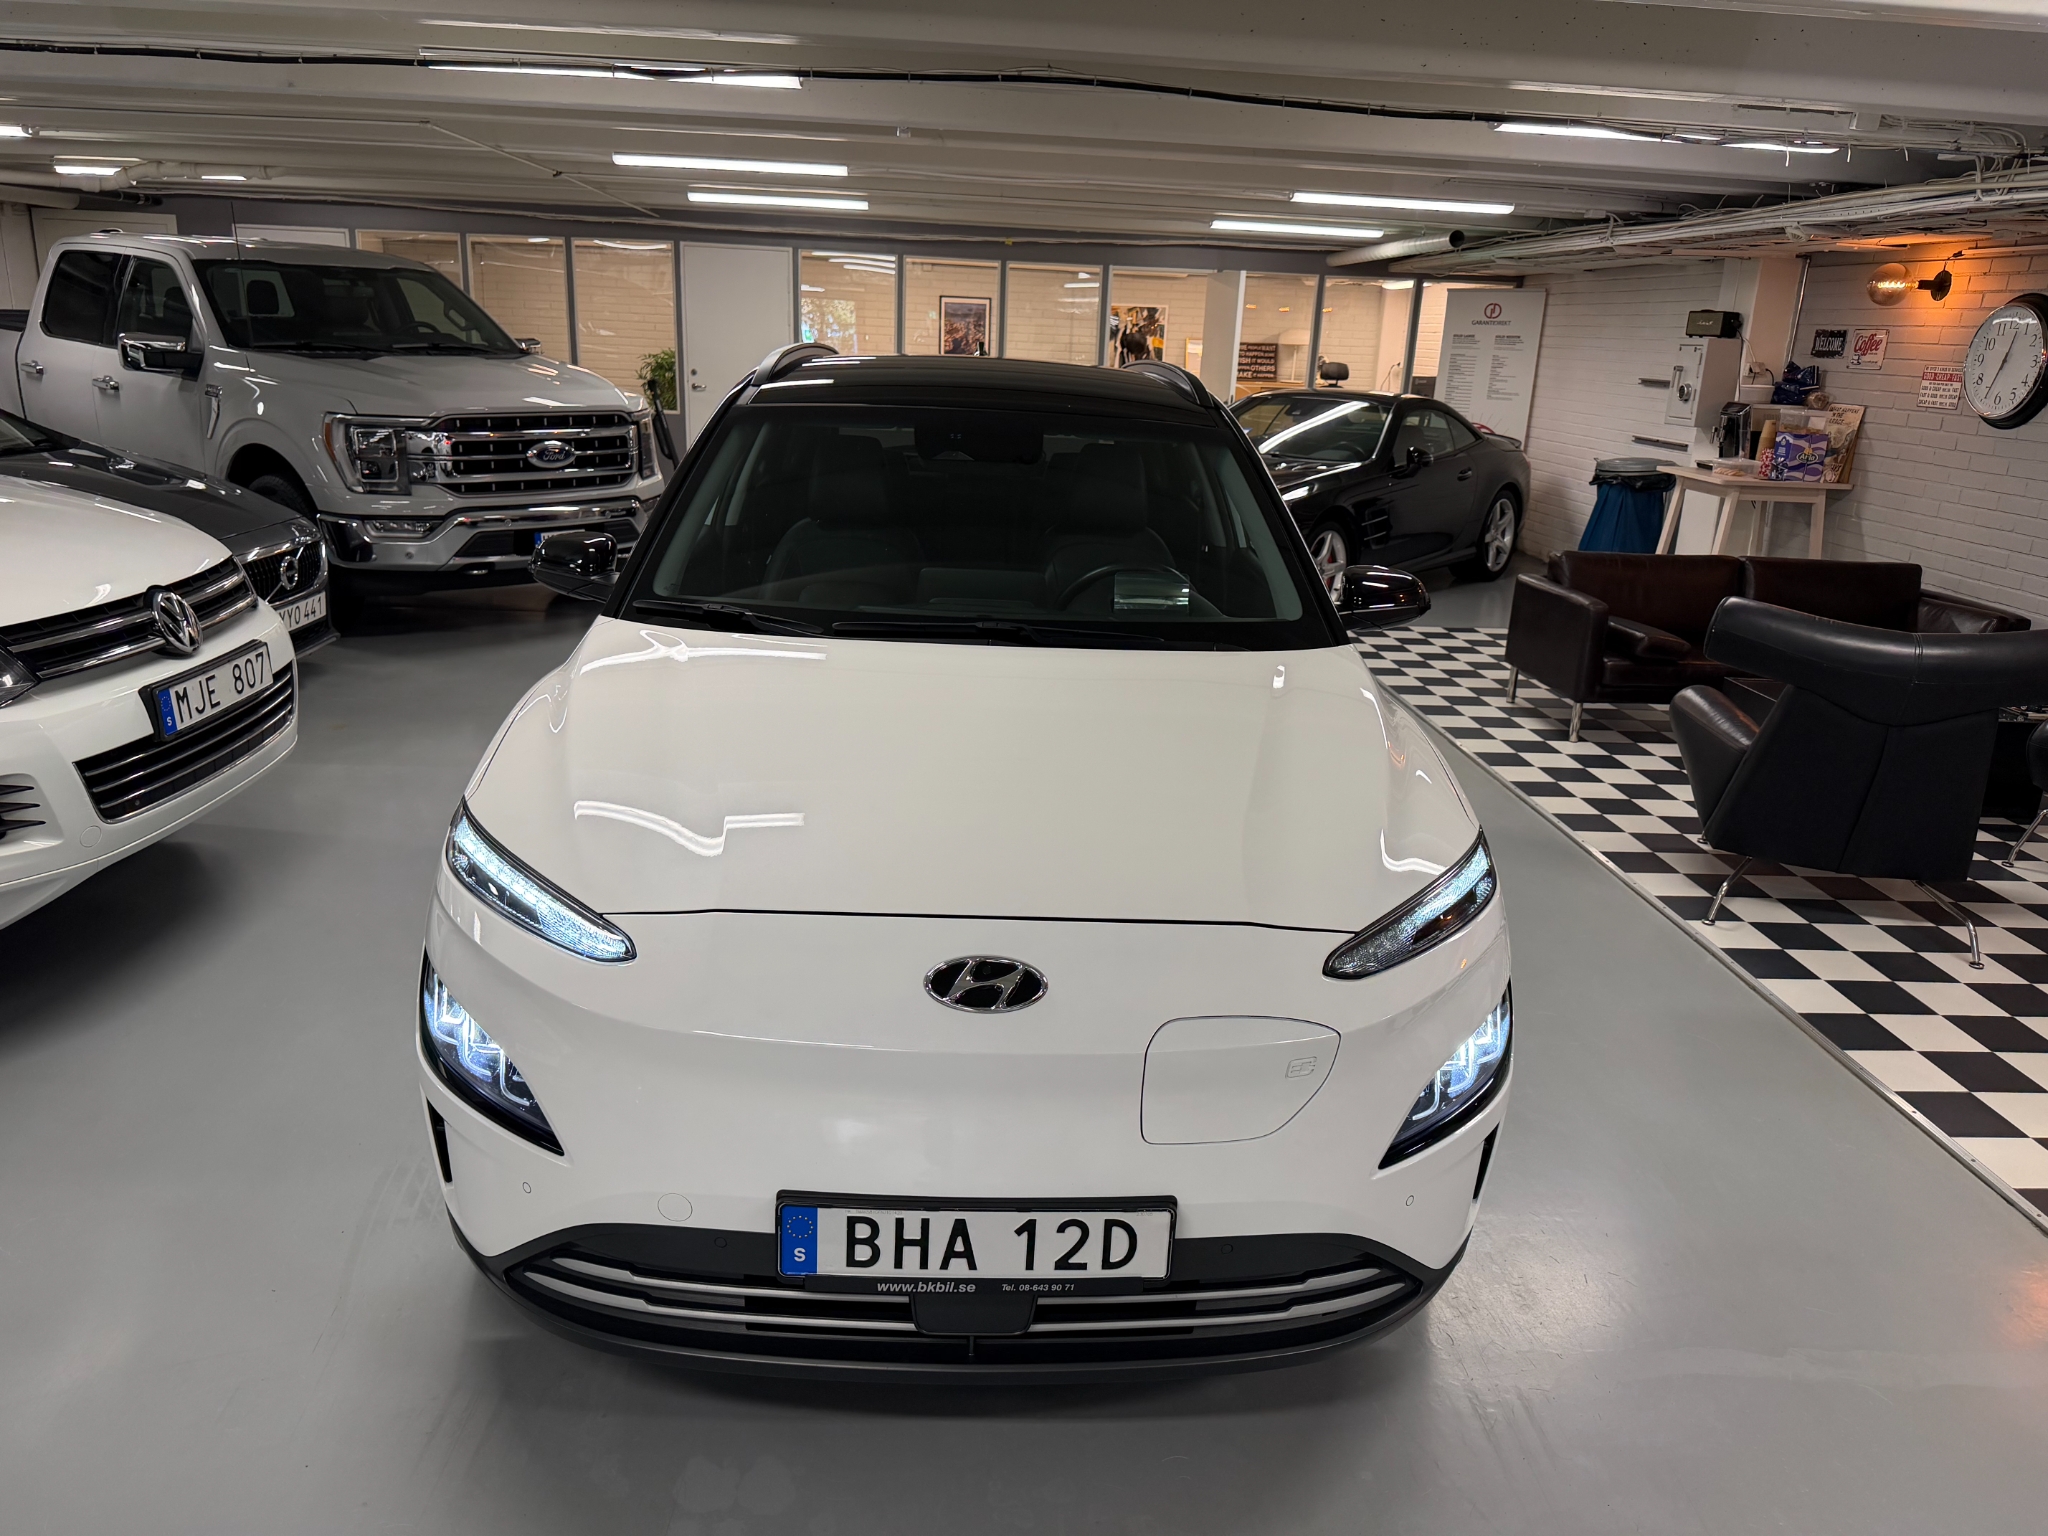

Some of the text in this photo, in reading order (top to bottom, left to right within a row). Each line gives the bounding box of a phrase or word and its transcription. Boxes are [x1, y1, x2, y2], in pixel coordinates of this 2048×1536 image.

[1815, 336, 1844, 351] WELCOME
[1854, 333, 1882, 356] Coffee
[1984, 338, 1996, 351] 10
[1977, 353, 1985, 367] 9
[2030, 355, 2039, 368] 3
[1976, 372, 1984, 386] 8
[1993, 391, 2002, 406] 6
[2009, 388, 2017, 401] 5
[542, 450, 566, 461] Ford
[303, 596, 322, 620] 441
[166, 651, 264, 726] S MJE 807
[794, 1215, 1138, 1271] S BHA 12D
[877, 1281, 976, 1293] www.bkbil.se
[1001, 1283, 1016, 1291] Tel.
[1019, 1284, 1049, 1292] 08-643
[1051, 1284, 1062, 1292] 90
